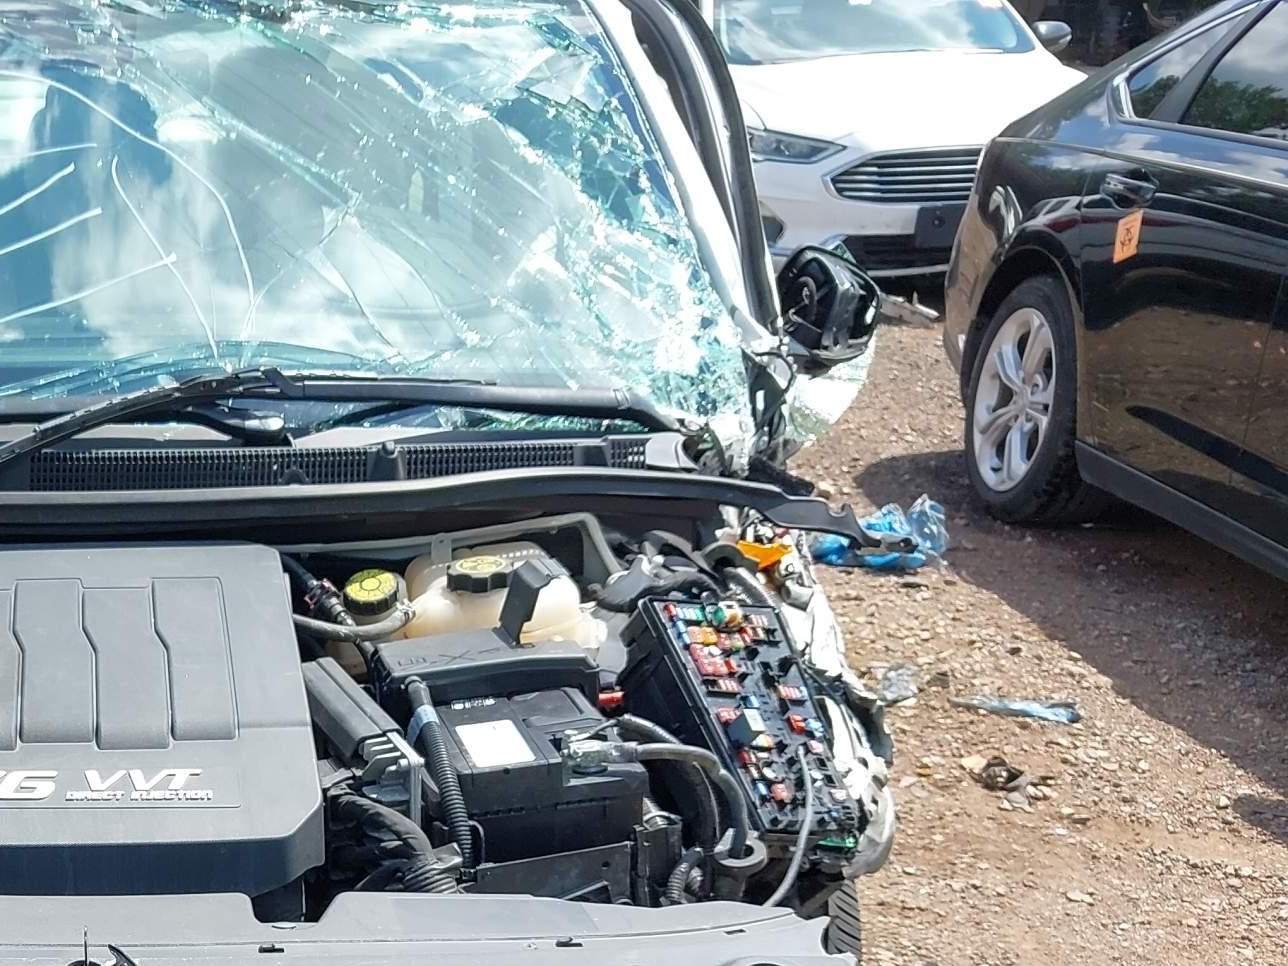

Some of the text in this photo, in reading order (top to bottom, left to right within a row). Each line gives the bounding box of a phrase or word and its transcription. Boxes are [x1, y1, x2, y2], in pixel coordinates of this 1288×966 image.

[84, 768, 203, 791] VVT
[65, 789, 214, 801] DIRECT INJECTION
